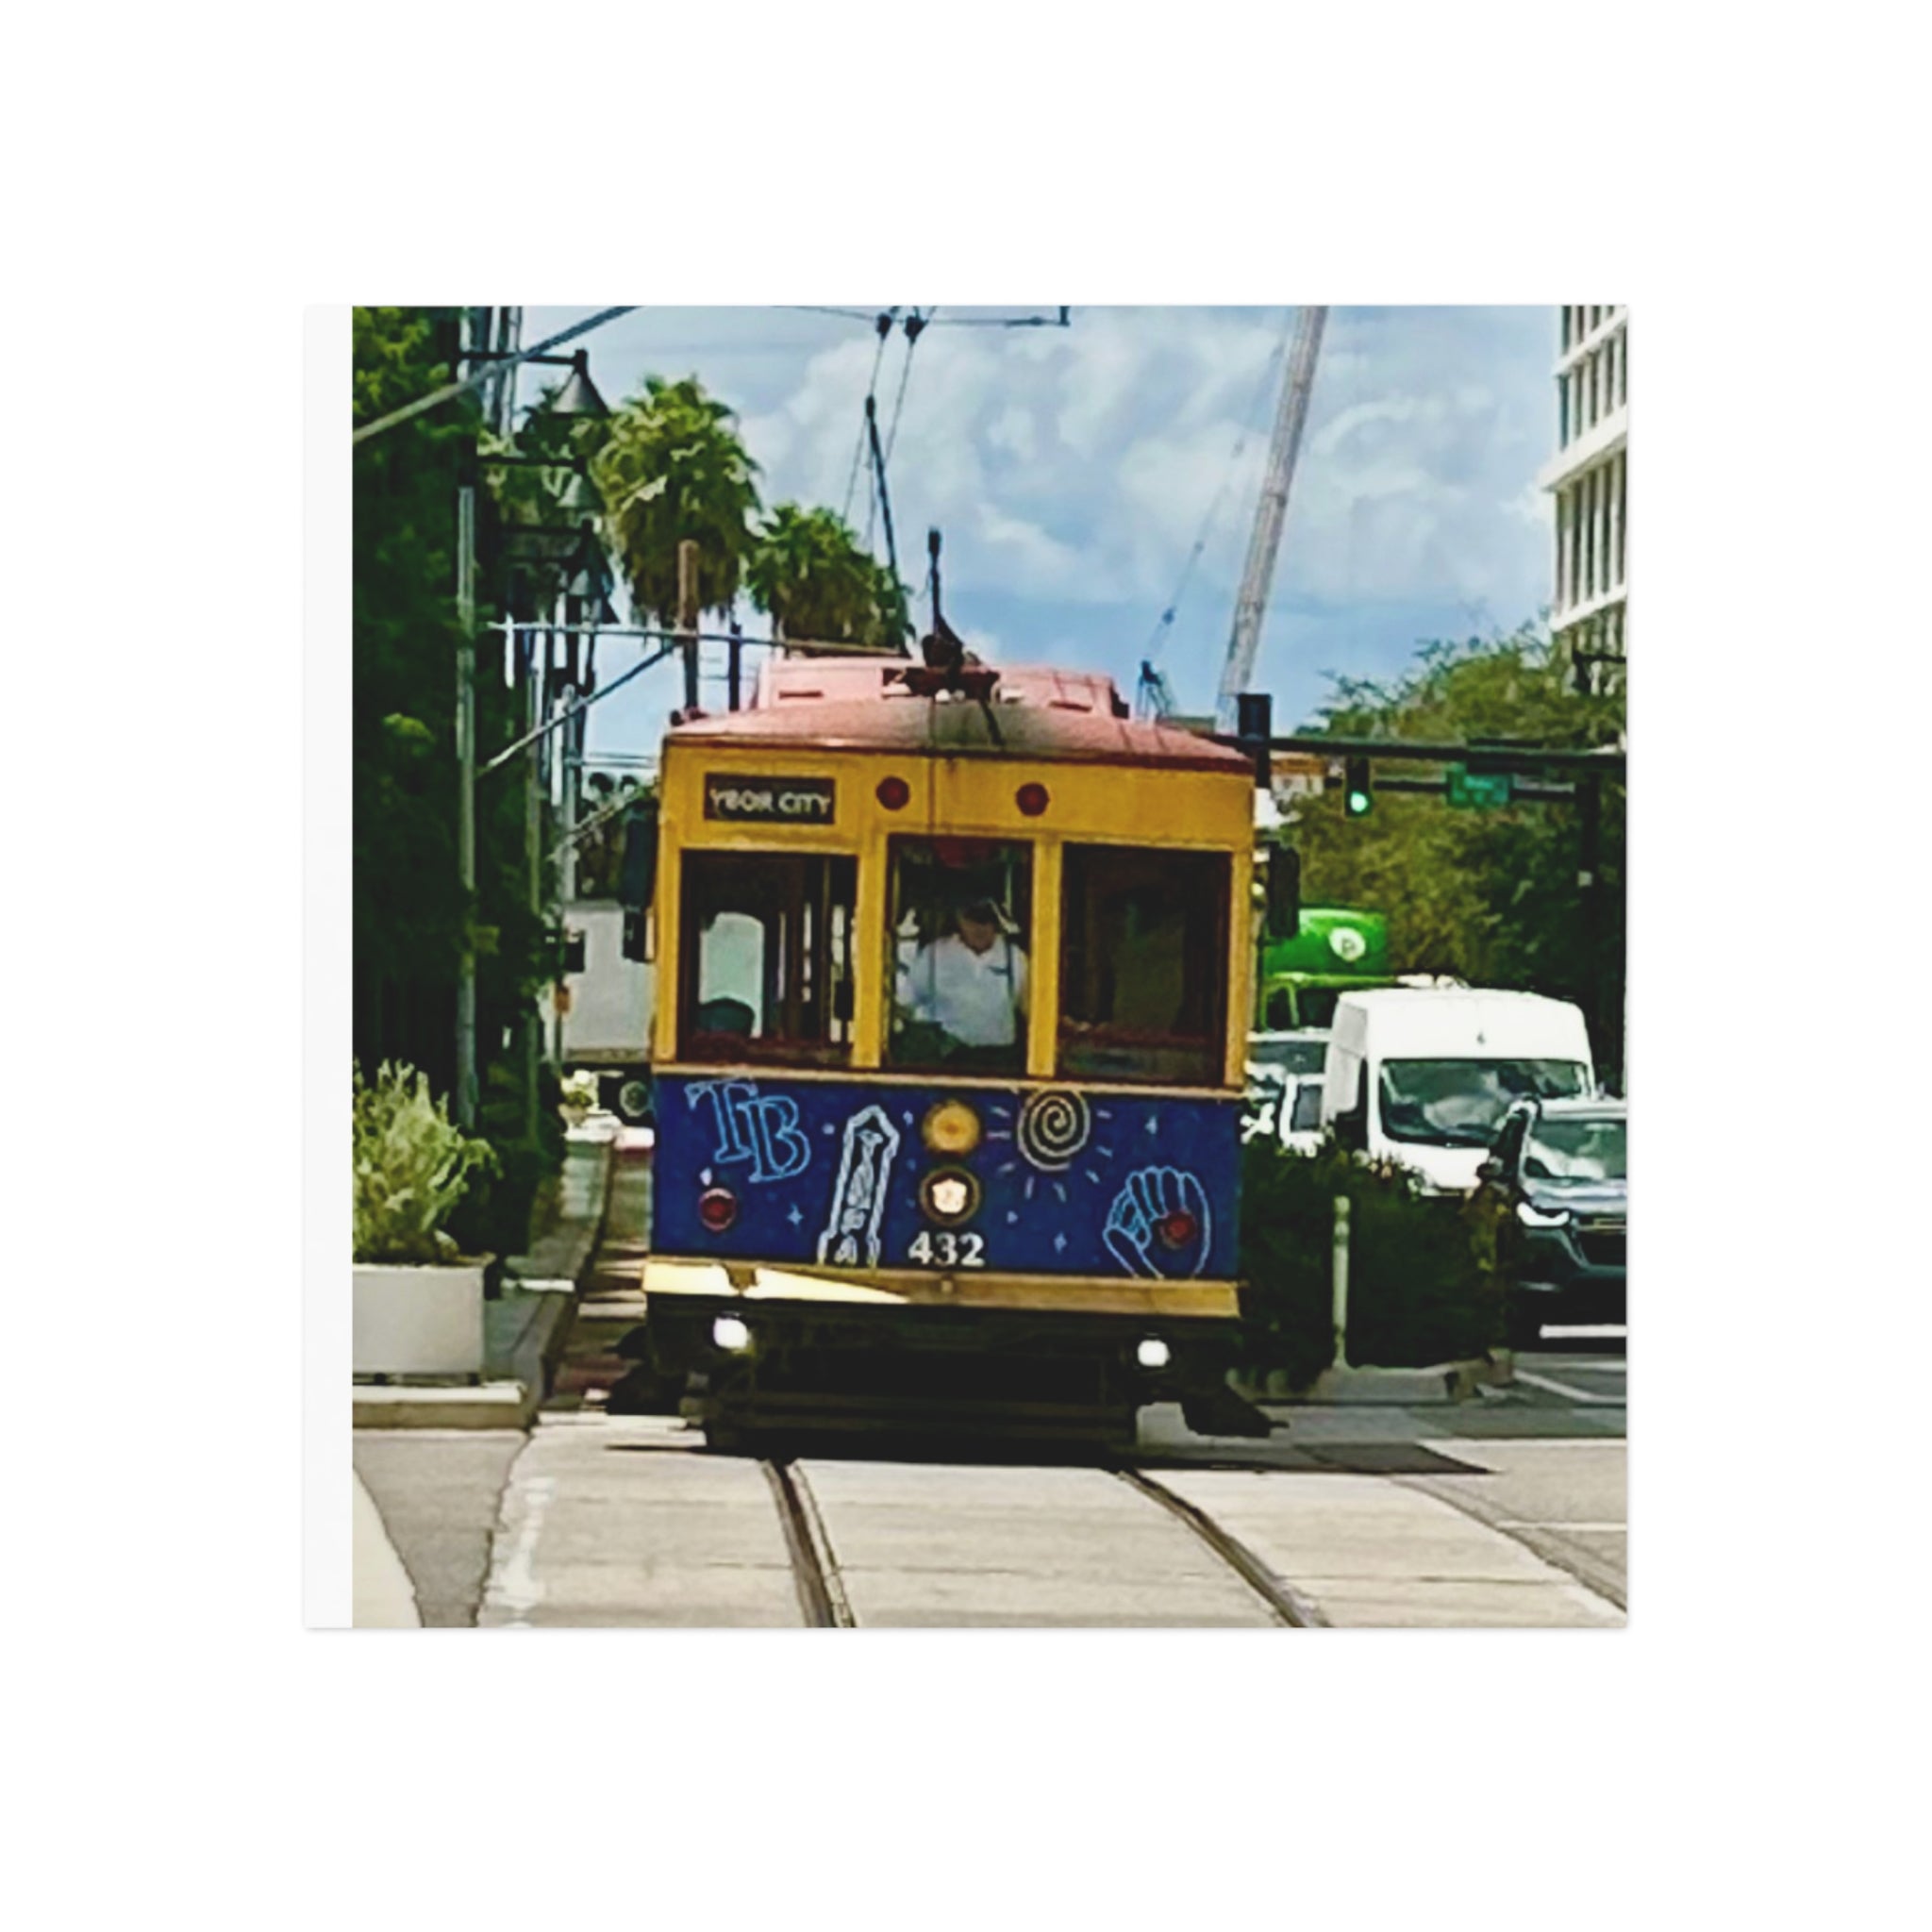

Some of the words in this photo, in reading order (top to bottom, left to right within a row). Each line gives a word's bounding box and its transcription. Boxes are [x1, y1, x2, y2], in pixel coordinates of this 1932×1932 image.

[709, 789, 774, 811] YBOR
[778, 791, 831, 815] CITY
[684, 1079, 811, 1183] TB
[908, 1230, 985, 1267] 432
